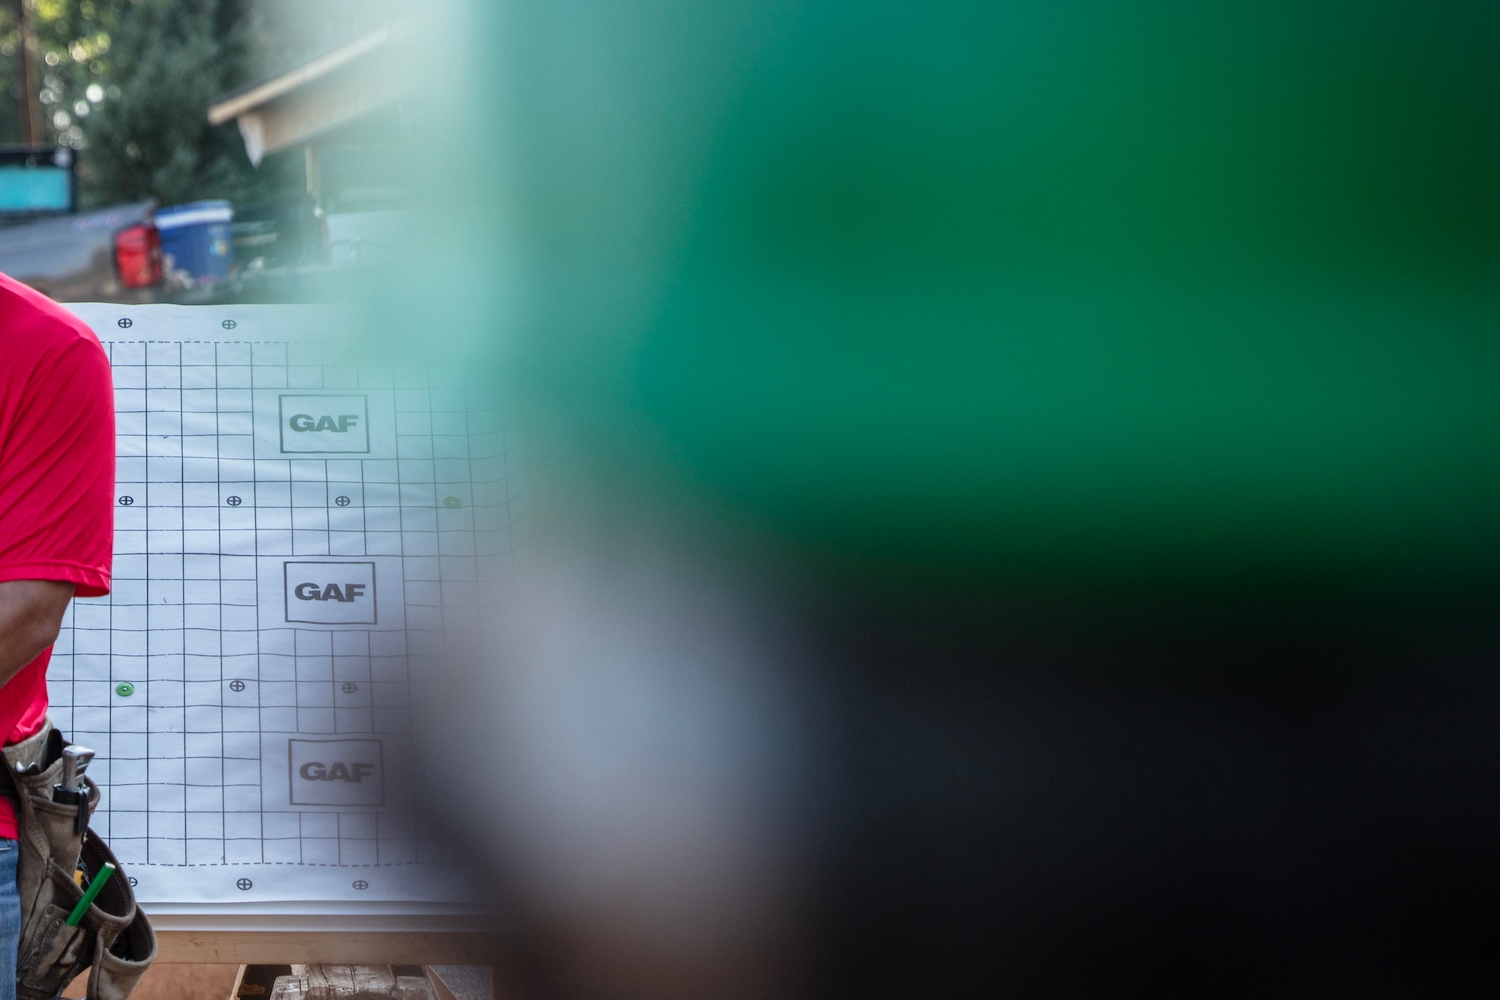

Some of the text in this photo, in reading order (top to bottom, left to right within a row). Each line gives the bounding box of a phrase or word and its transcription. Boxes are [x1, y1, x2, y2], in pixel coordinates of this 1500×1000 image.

[289, 413, 359, 433] GAF
[294, 582, 366, 602] GAF
[299, 761, 374, 783] GAF
